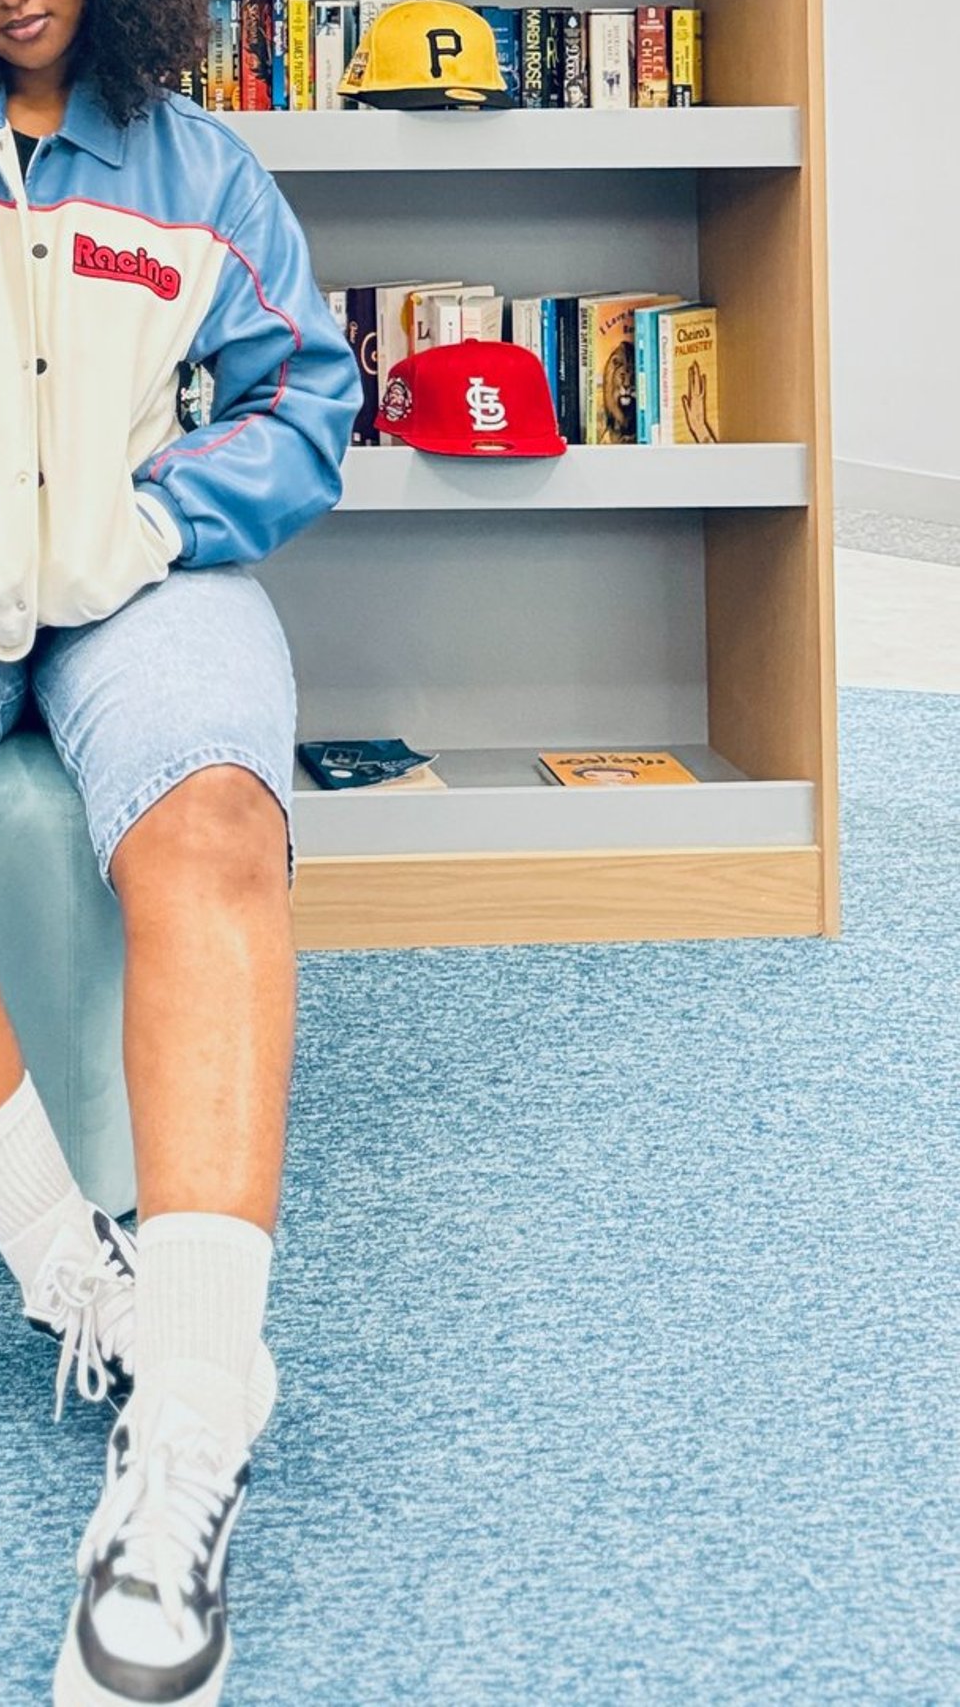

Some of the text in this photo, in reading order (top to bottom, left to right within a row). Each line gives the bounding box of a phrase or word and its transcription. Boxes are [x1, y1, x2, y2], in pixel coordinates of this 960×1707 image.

[294, 38, 304, 96] JAMES PATTERSON
[426, 28, 463, 78] P
[525, 9, 542, 90] KAREN ROSE
[641, 38, 652, 80] CHILD
[653, 46, 664, 73] LEE
[74, 234, 180, 297] Racing
[606, 313, 626, 328] Love
